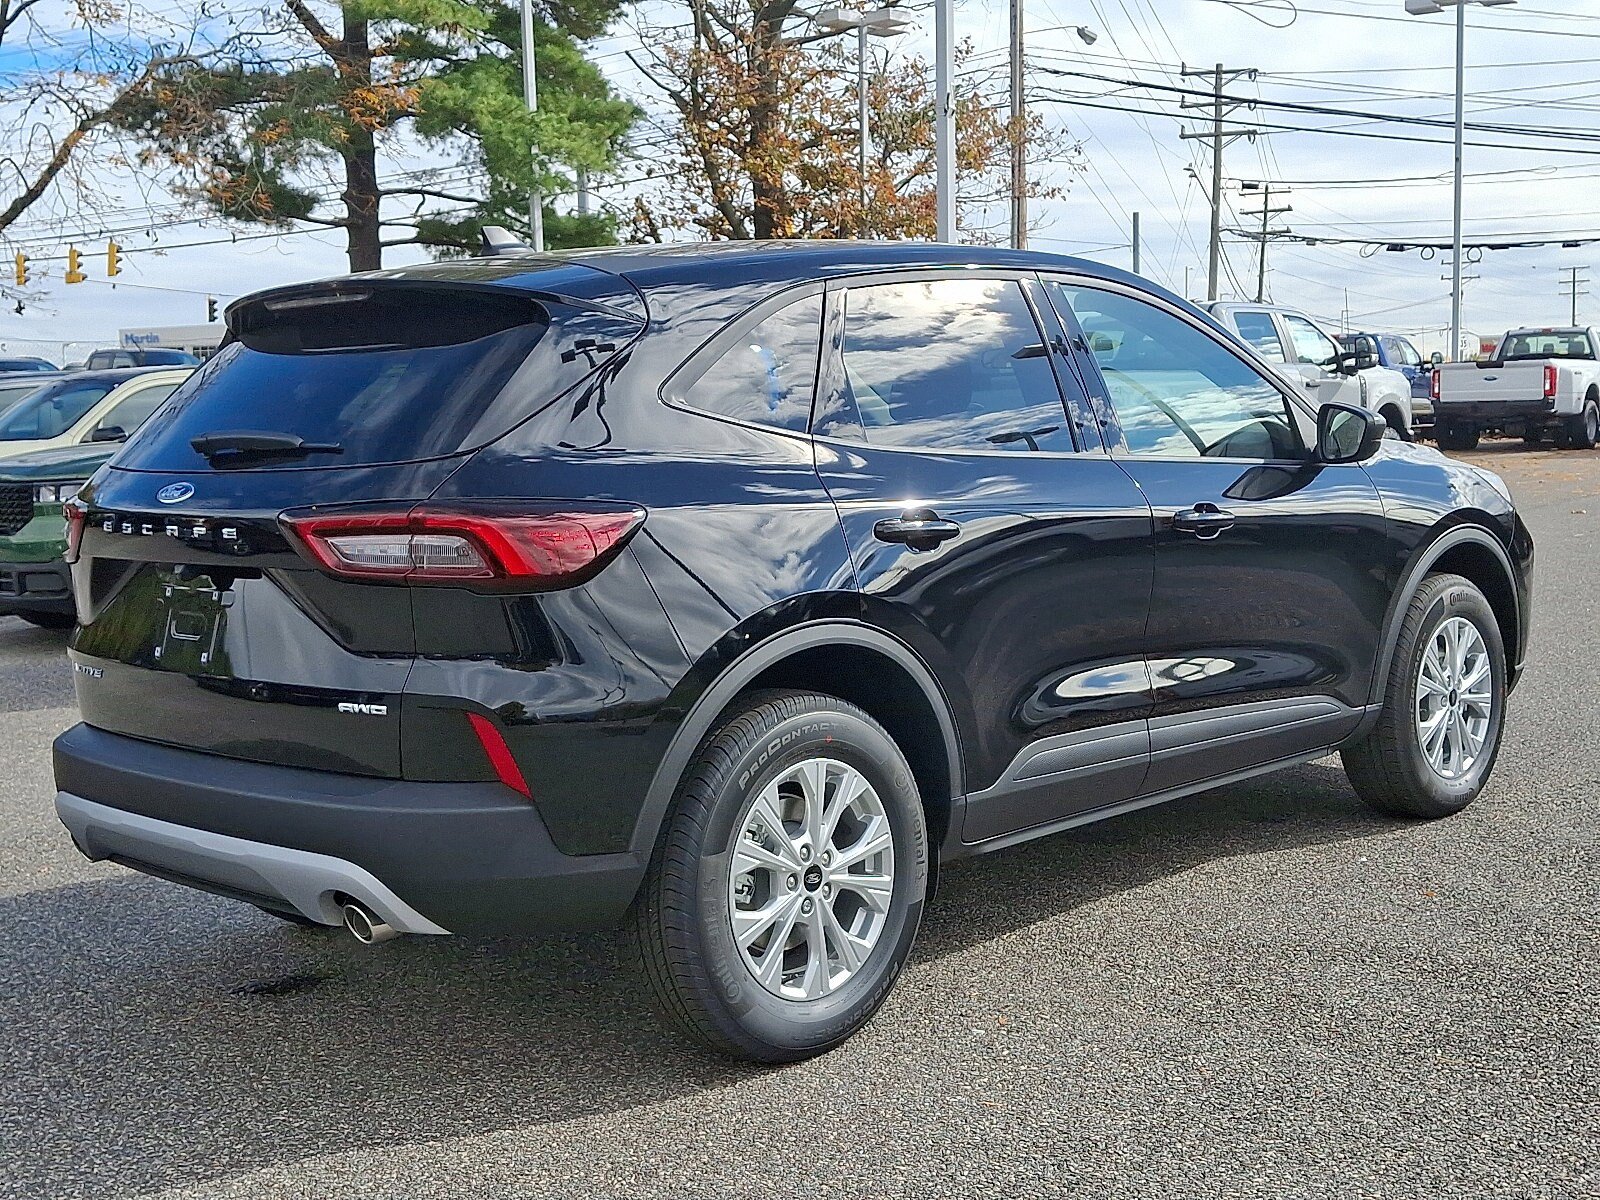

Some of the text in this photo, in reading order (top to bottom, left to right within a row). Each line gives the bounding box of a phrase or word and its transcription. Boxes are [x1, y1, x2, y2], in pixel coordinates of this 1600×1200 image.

[124, 332, 160, 344] Martin
[159, 483, 190, 501] Ford
[103, 520, 238, 540] ESCAPE
[338, 702, 388, 715] AWD
[894, 767, 925, 866] Connental
